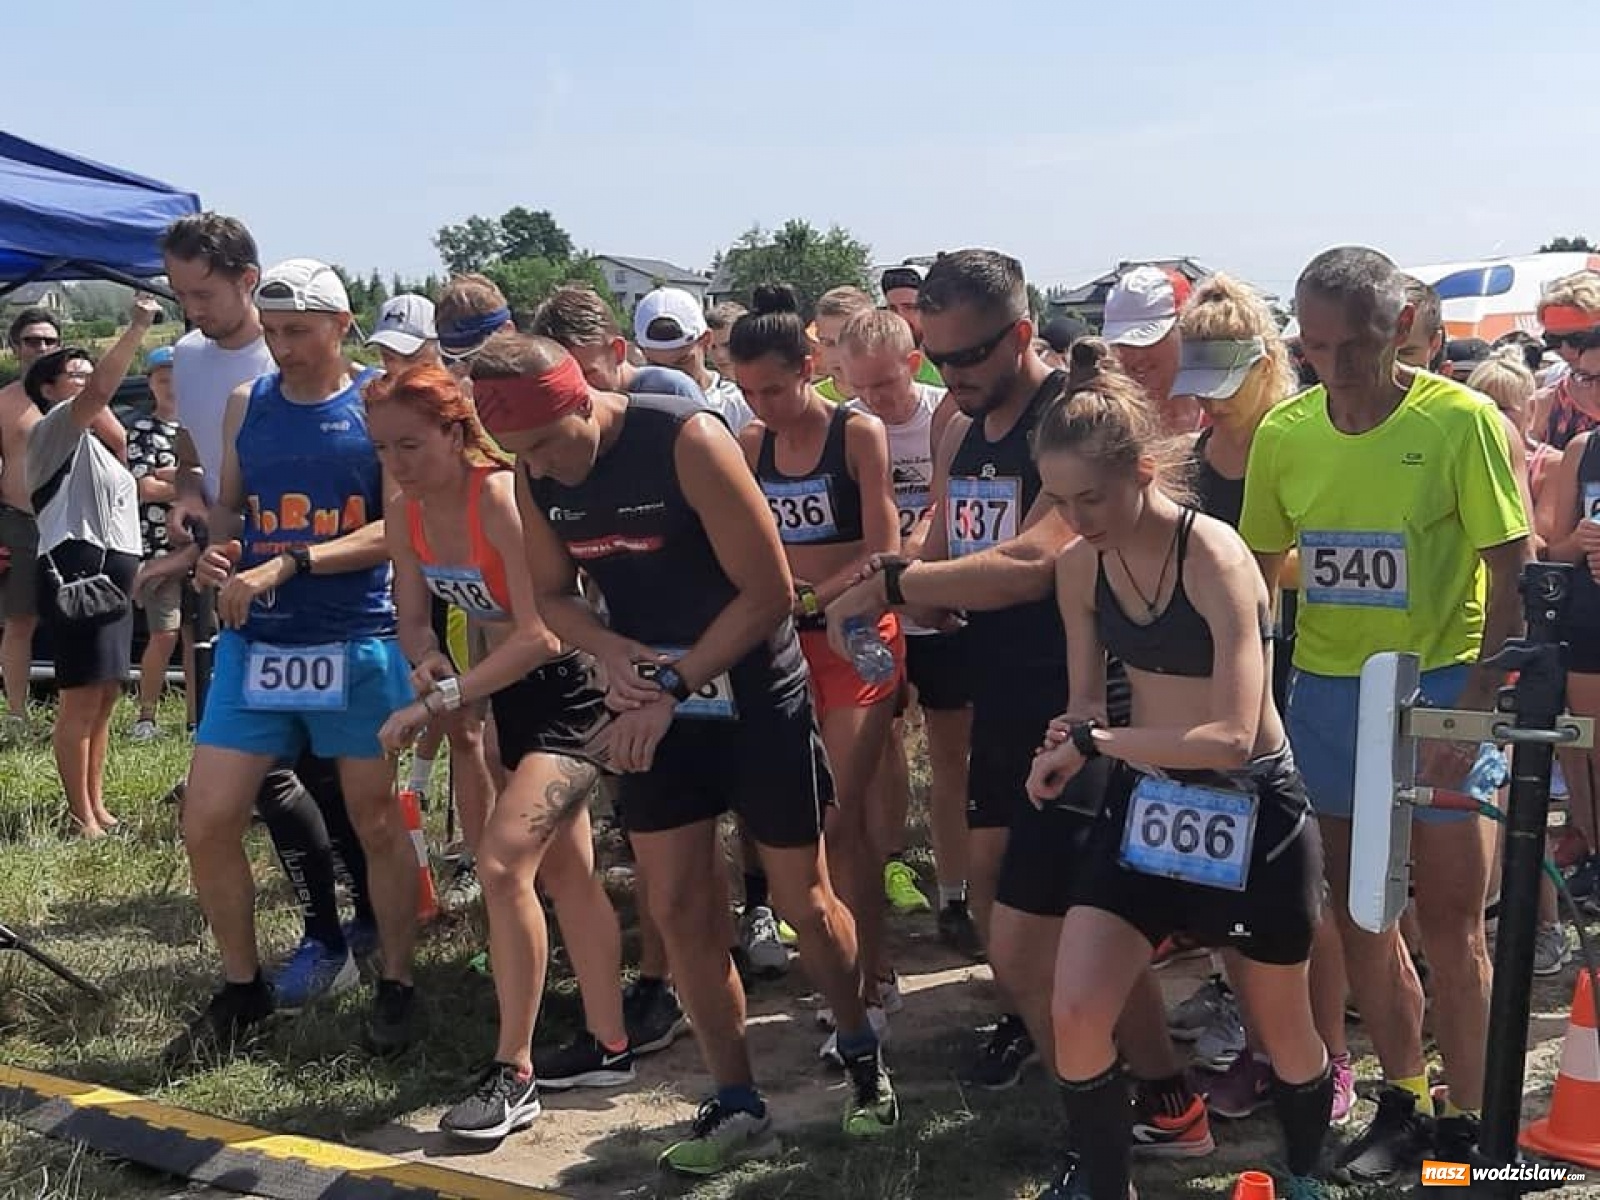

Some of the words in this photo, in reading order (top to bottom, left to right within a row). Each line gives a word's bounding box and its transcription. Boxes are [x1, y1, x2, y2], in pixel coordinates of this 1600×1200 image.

[768, 494, 825, 528] 536
[955, 499, 1009, 540] 537
[1314, 549, 1398, 589] 540
[434, 579, 494, 610] 518
[260, 656, 334, 690] 500
[1142, 802, 1236, 859] 666
